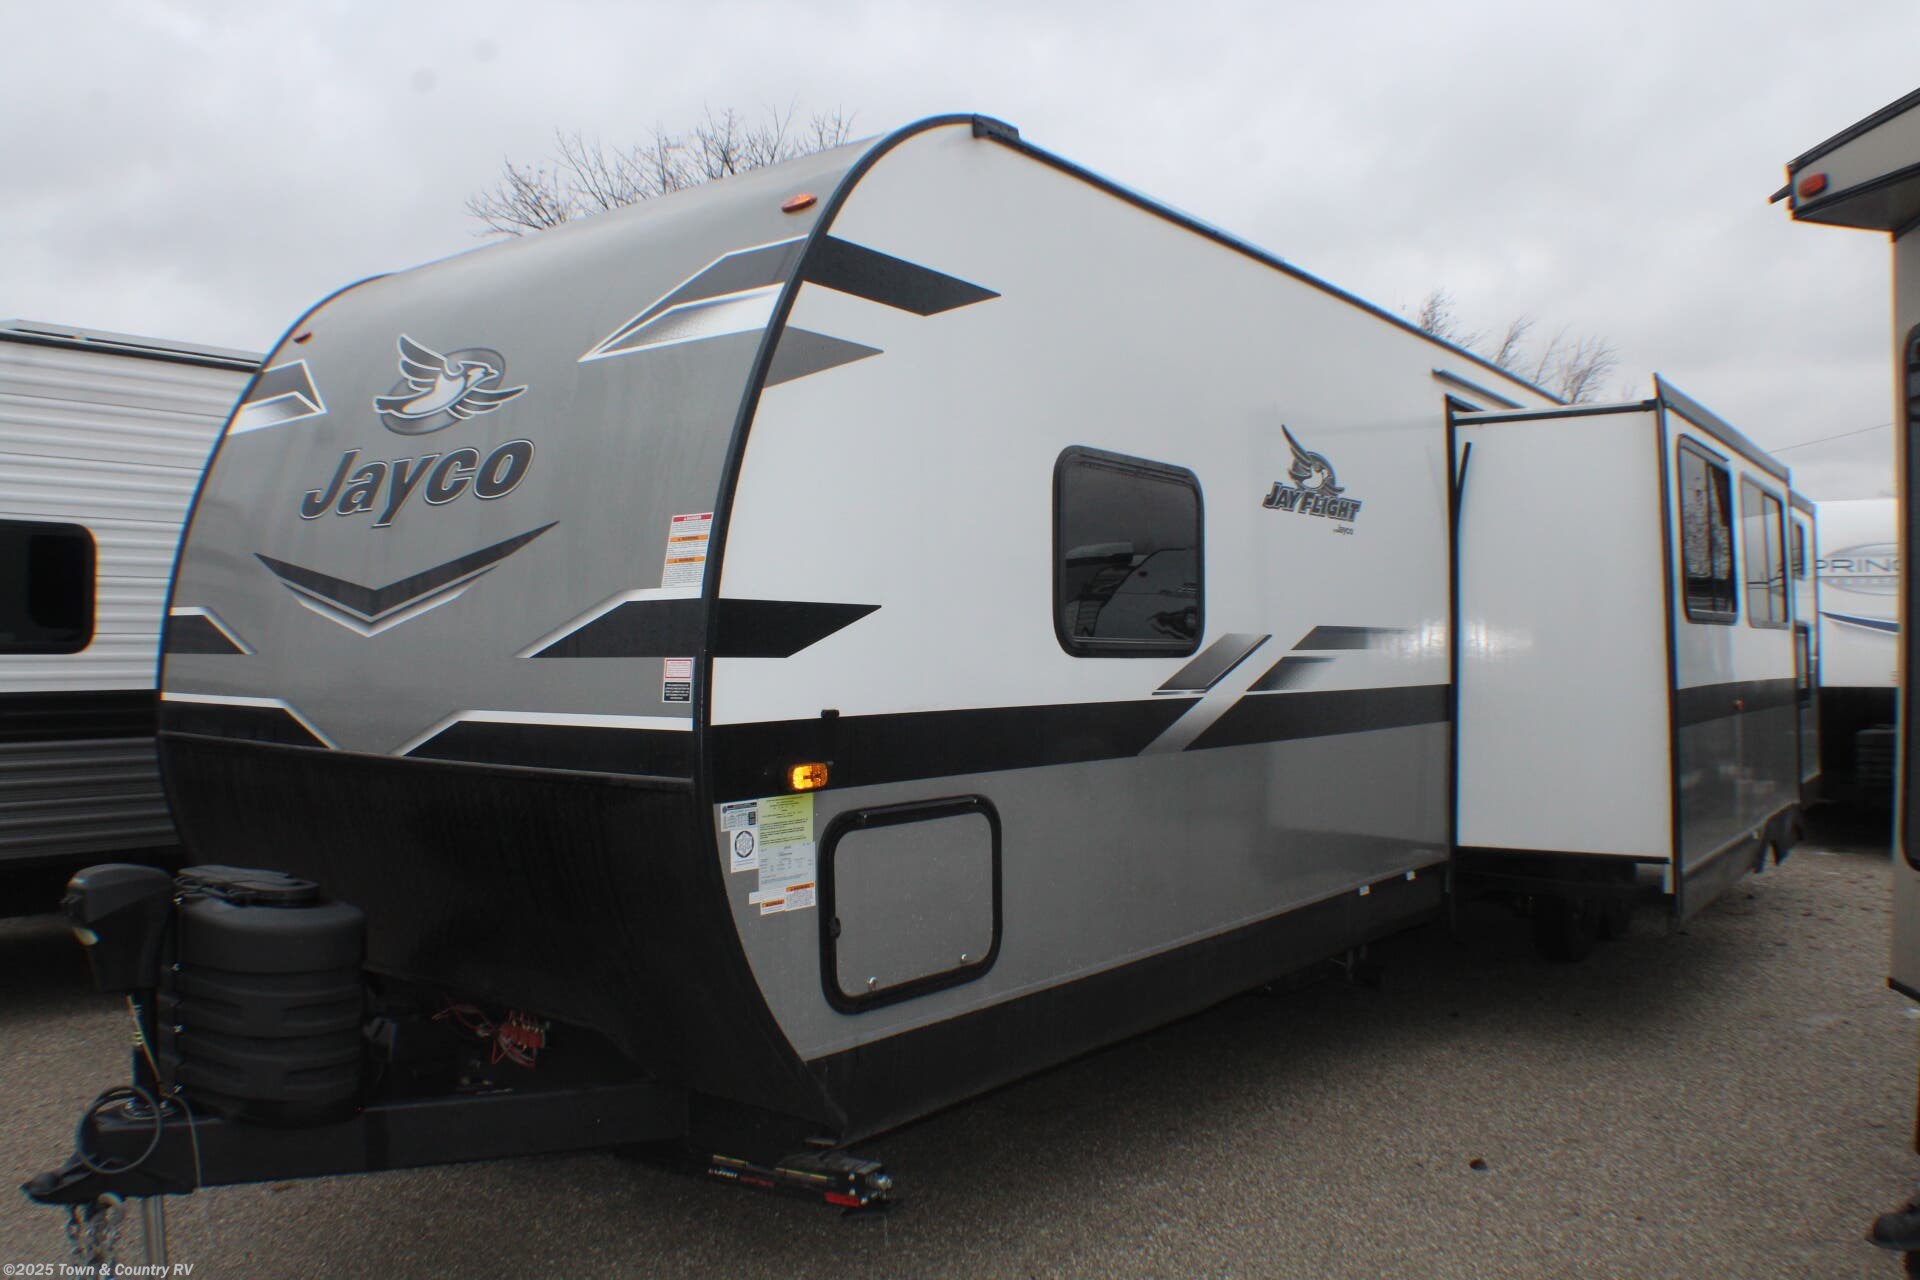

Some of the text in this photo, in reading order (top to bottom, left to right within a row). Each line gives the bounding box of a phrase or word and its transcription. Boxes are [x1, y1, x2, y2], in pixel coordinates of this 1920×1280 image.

[299, 438, 536, 528] Jayco
[1262, 481, 1362, 522] JAY FLIGHT
